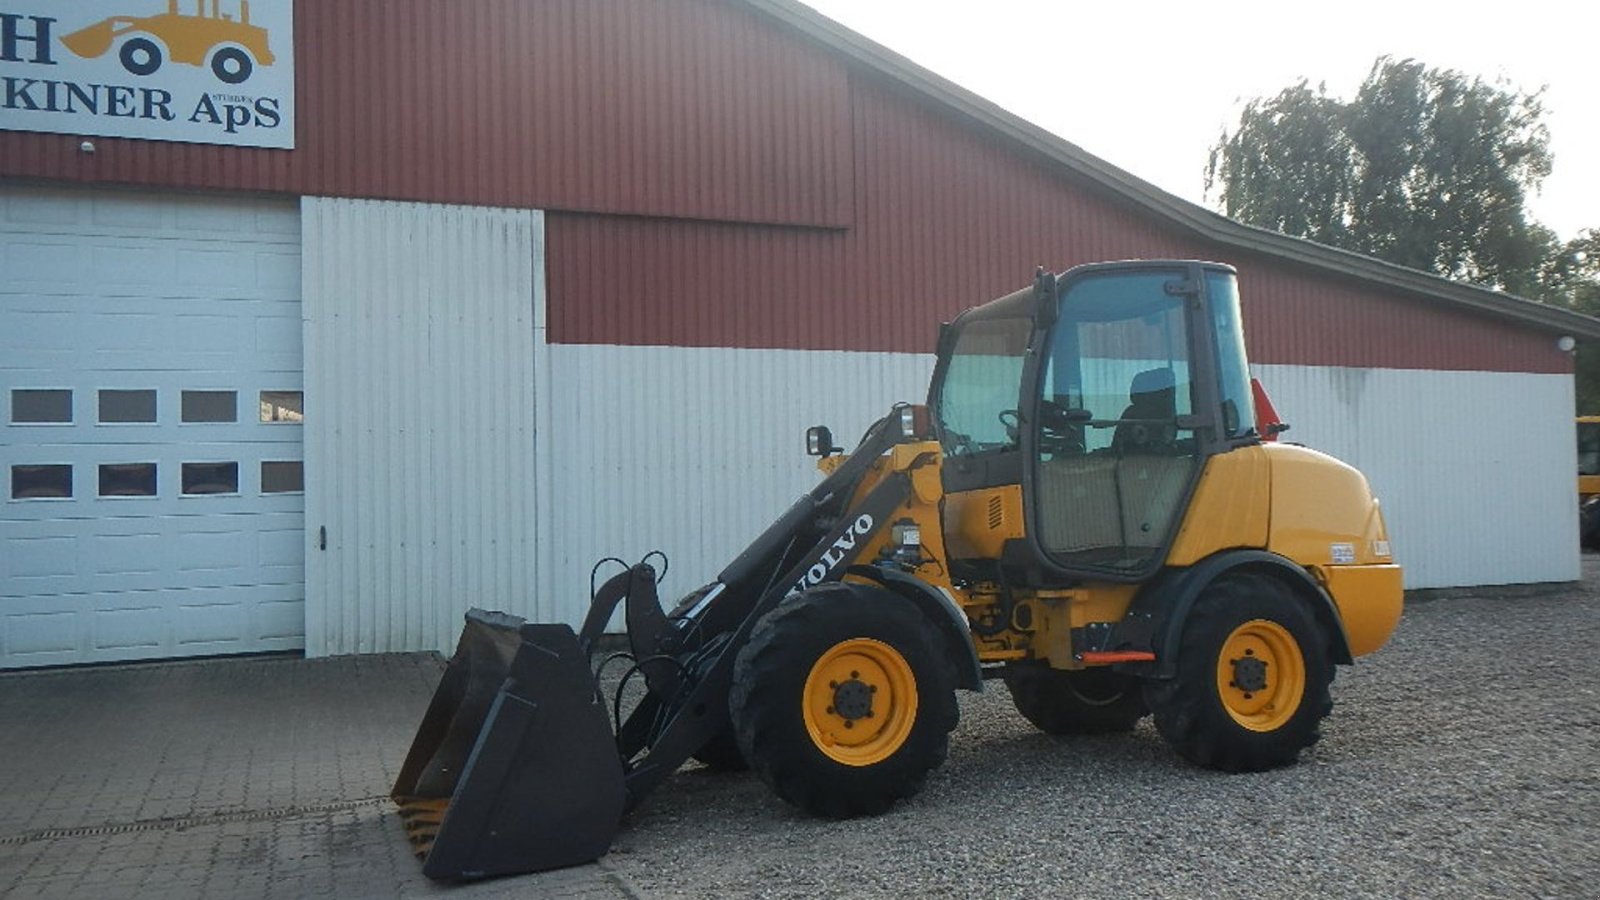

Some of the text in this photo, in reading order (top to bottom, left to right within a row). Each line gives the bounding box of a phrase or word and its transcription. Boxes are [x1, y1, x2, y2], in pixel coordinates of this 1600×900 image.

[0, 13, 57, 65] H
[1, 77, 281, 134] KINER ApS
